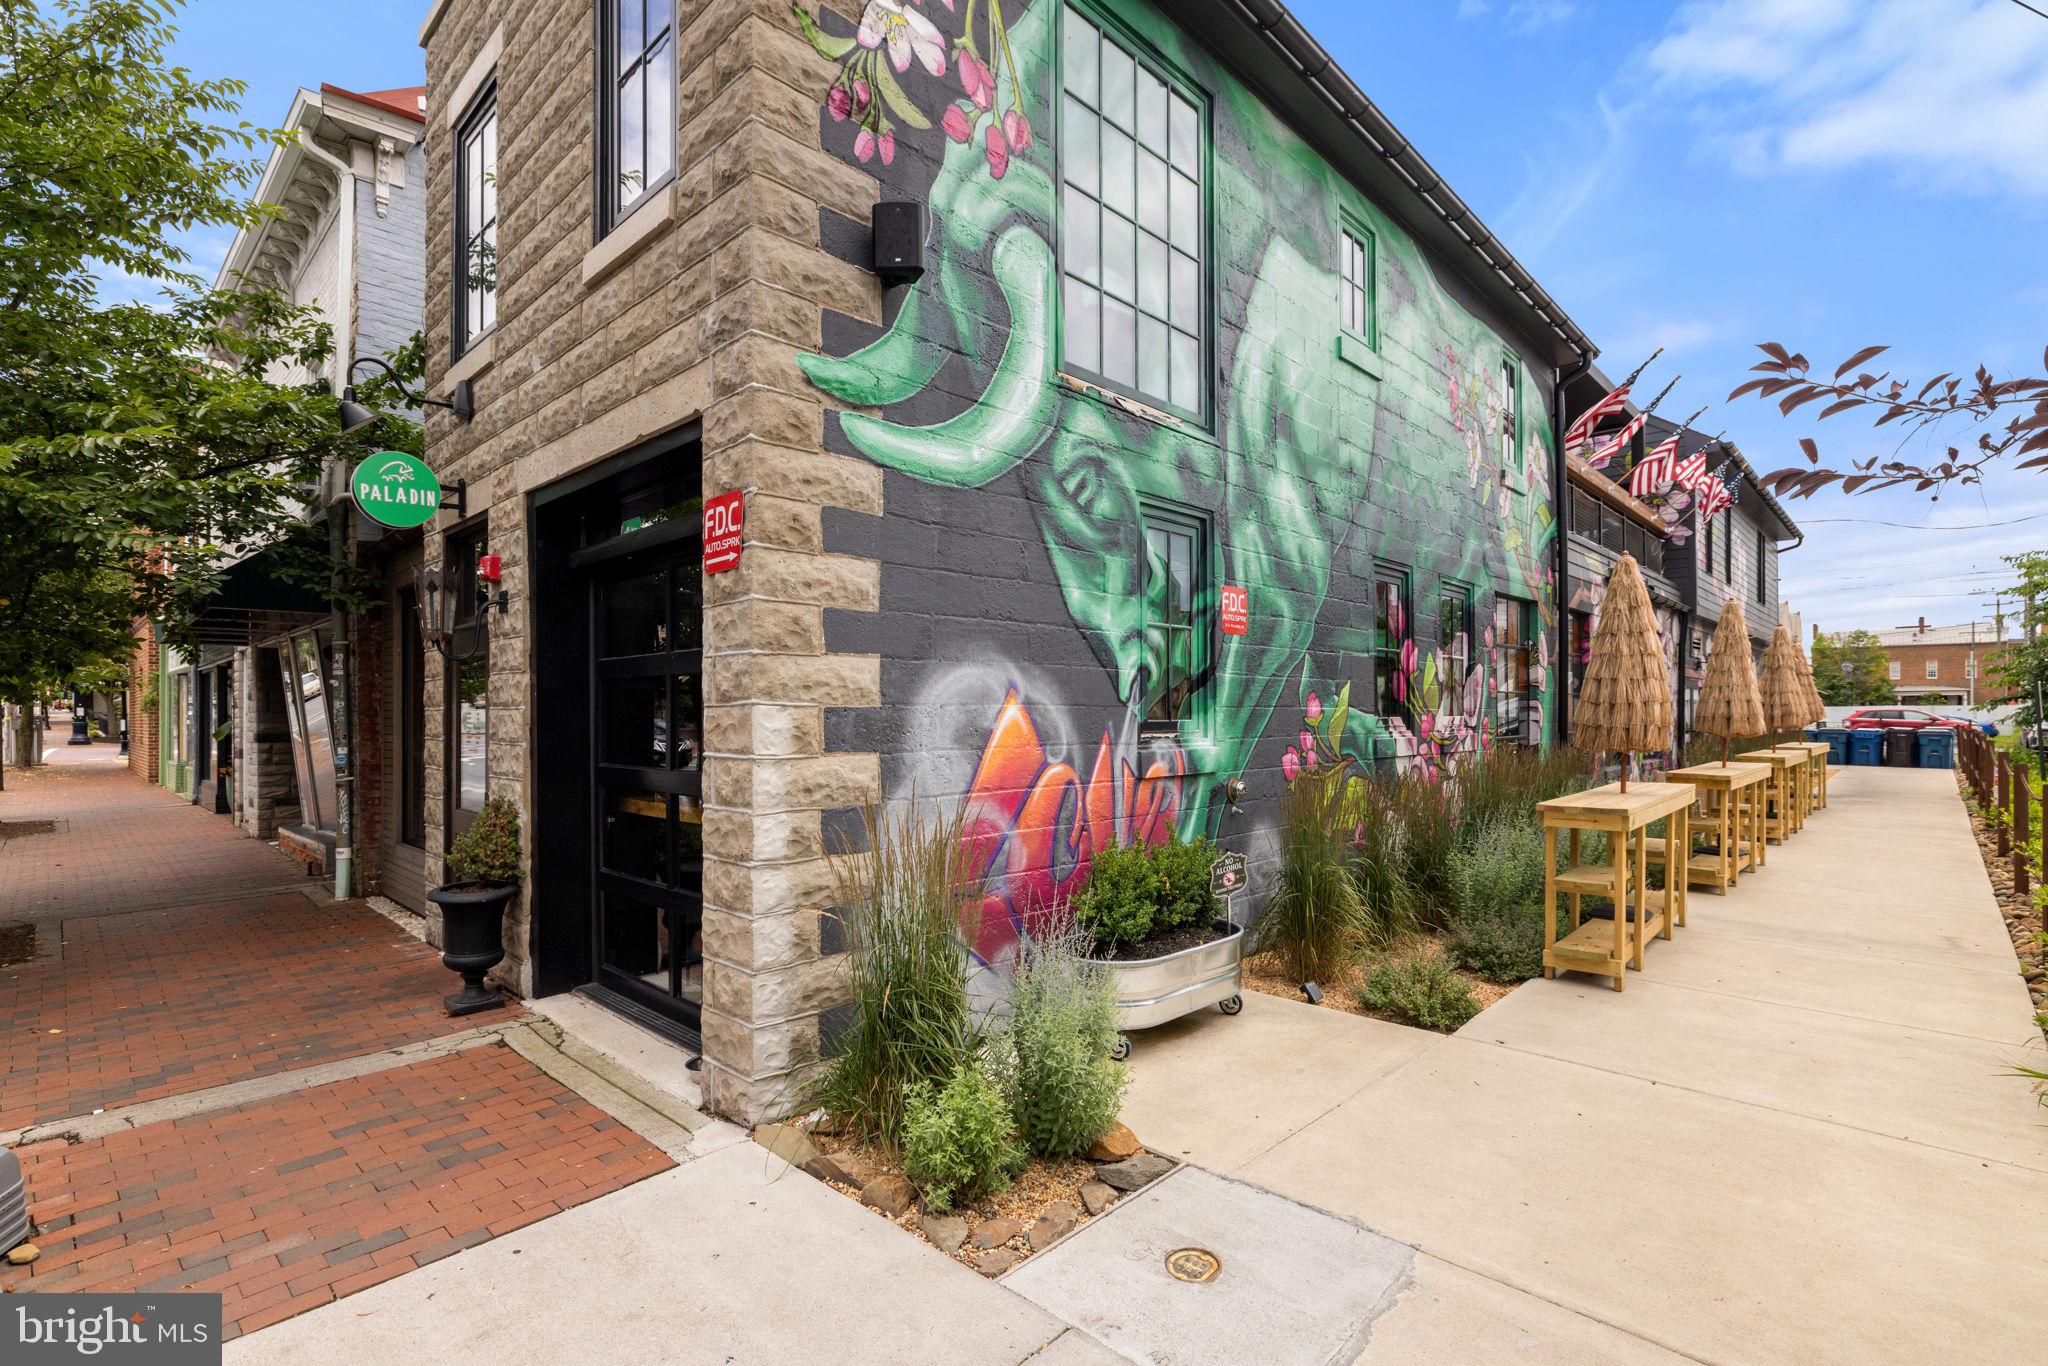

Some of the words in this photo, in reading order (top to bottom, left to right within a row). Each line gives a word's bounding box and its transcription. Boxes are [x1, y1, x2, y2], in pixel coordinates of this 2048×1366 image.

[360, 483, 436, 507] PALADIN
[1224, 857, 1234, 866] NO
[1215, 862, 1243, 875] ALCOHOL
